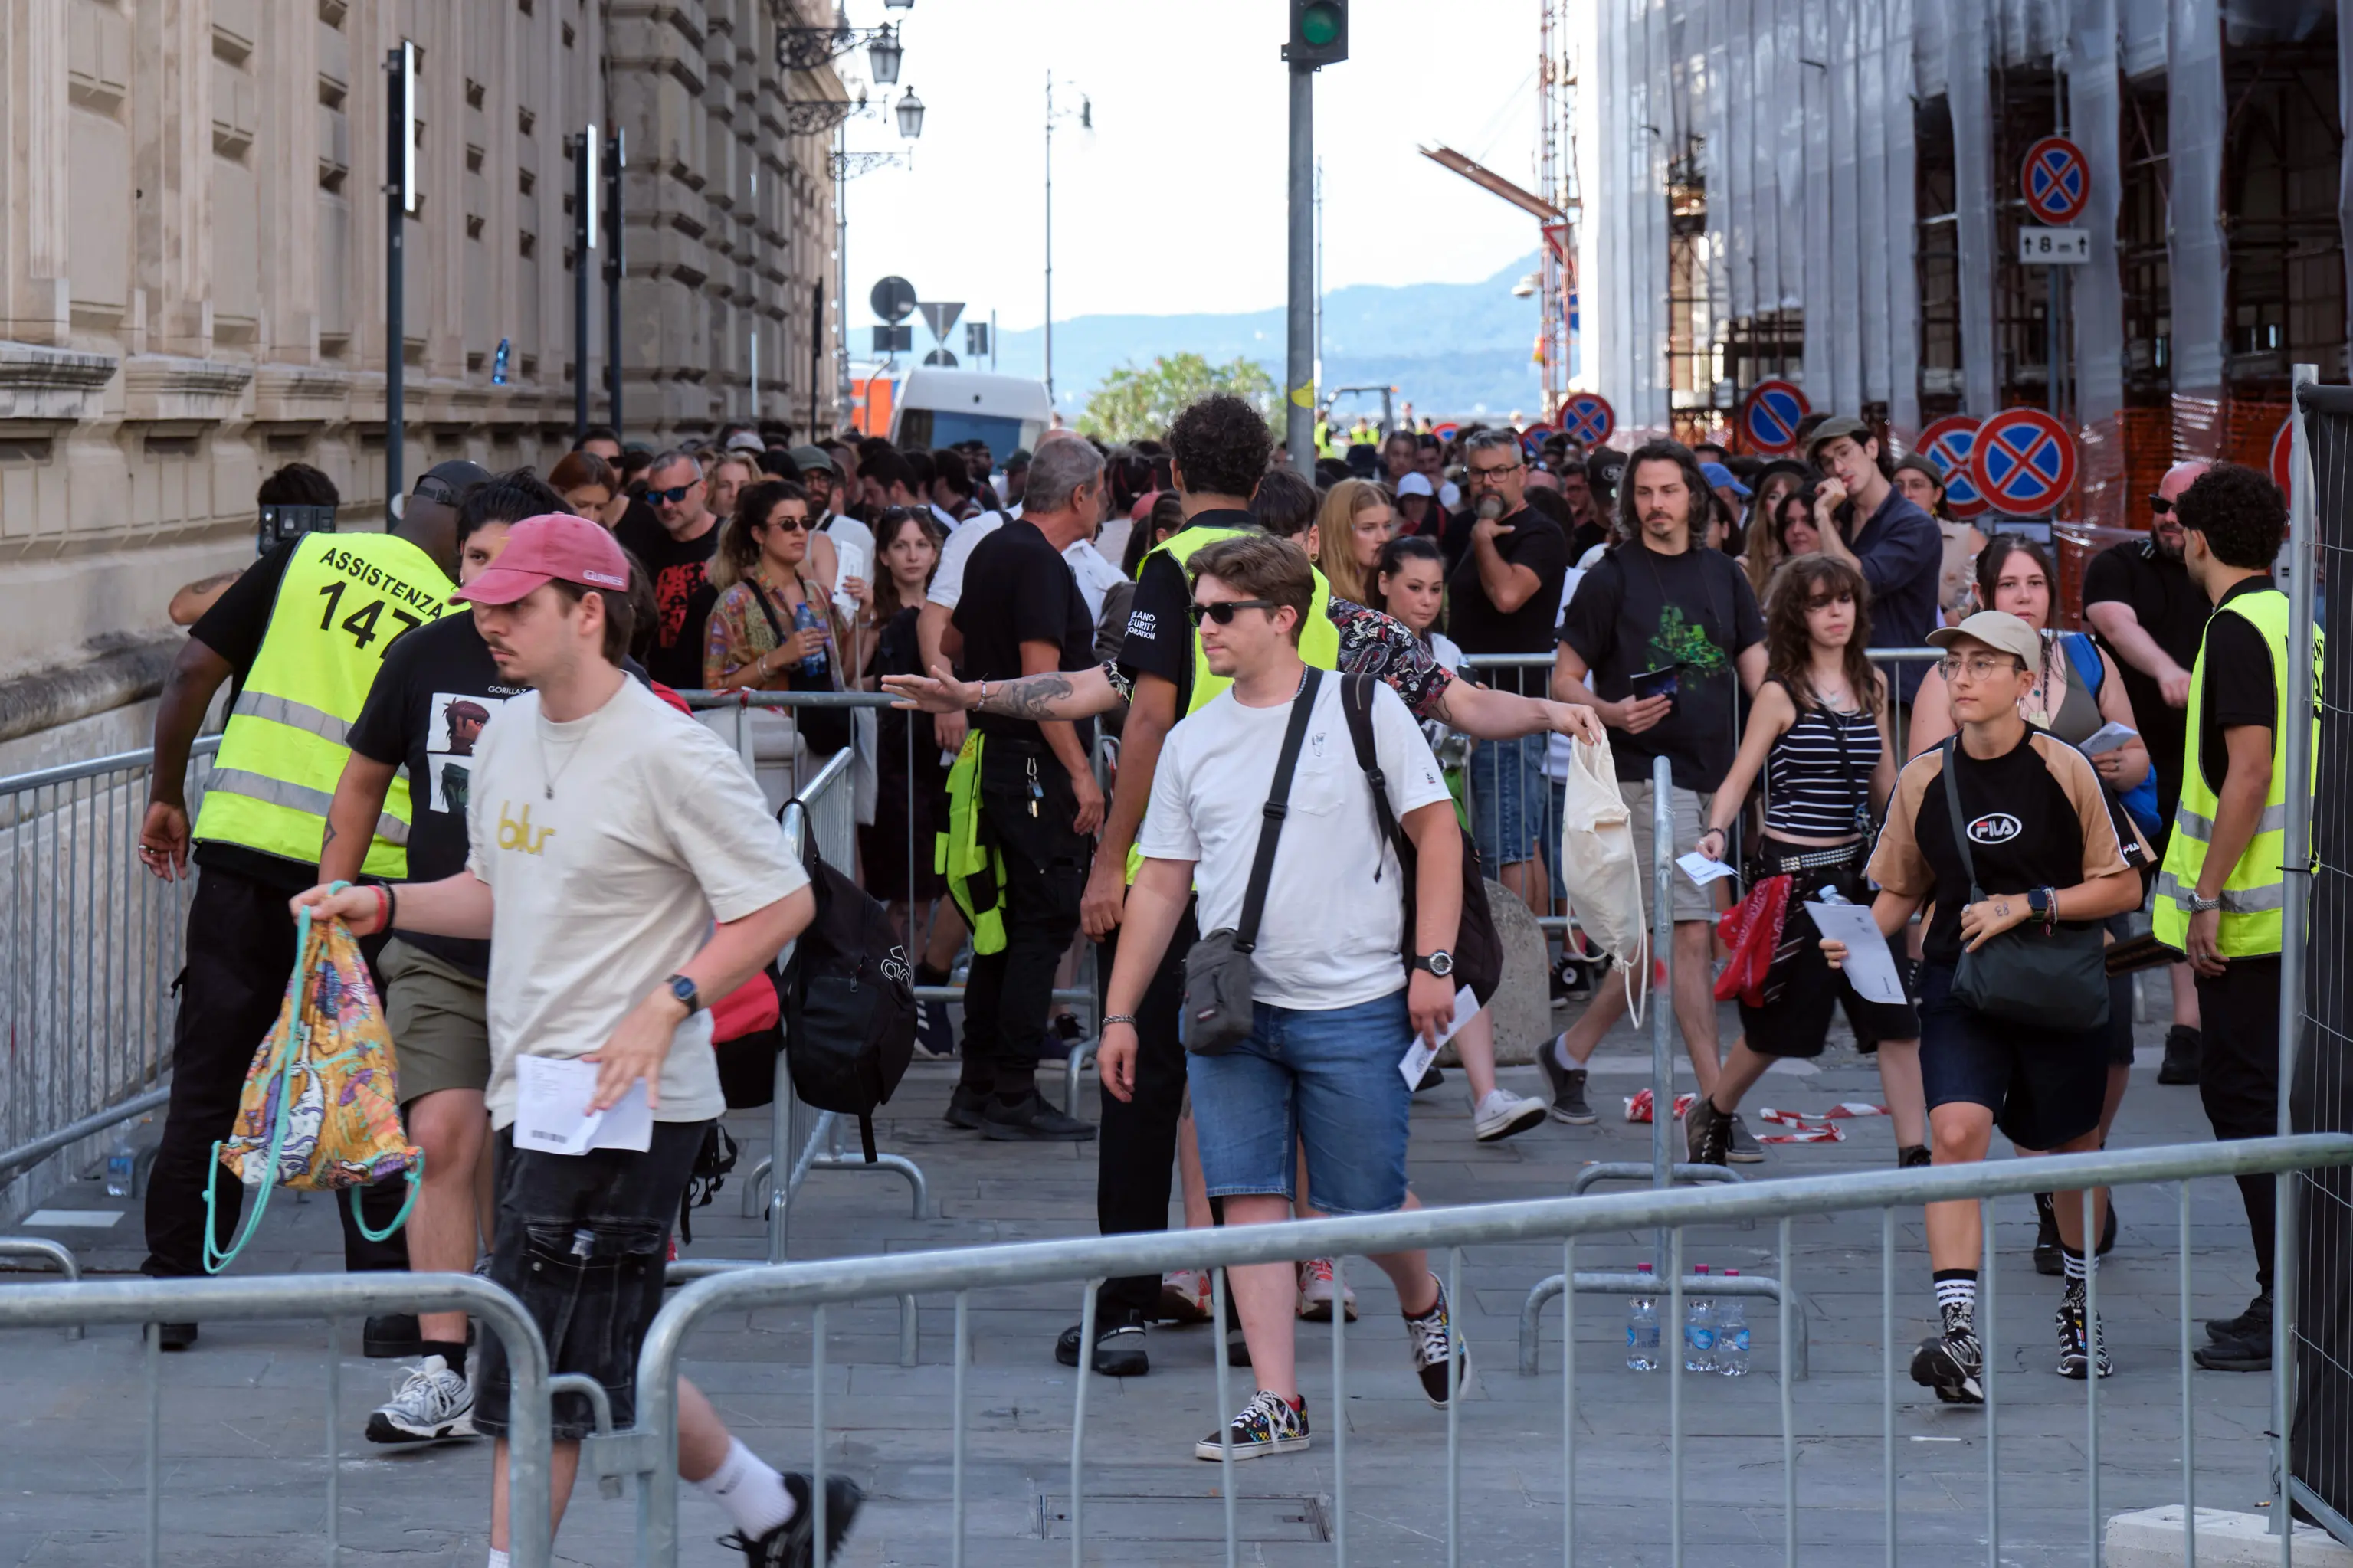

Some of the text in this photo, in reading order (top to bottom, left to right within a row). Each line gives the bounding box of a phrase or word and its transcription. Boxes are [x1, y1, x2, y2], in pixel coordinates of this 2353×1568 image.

[2039, 235, 2052, 254] 8
[319, 548, 444, 620] ASSISTENZA
[319, 581, 422, 660] 147
[1128, 619, 1156, 631] CURITY
[1130, 611, 1155, 621] LANO
[1125, 627, 1155, 640] ORATION
[496, 800, 556, 856] blur
[1976, 819, 2014, 838] FILA
